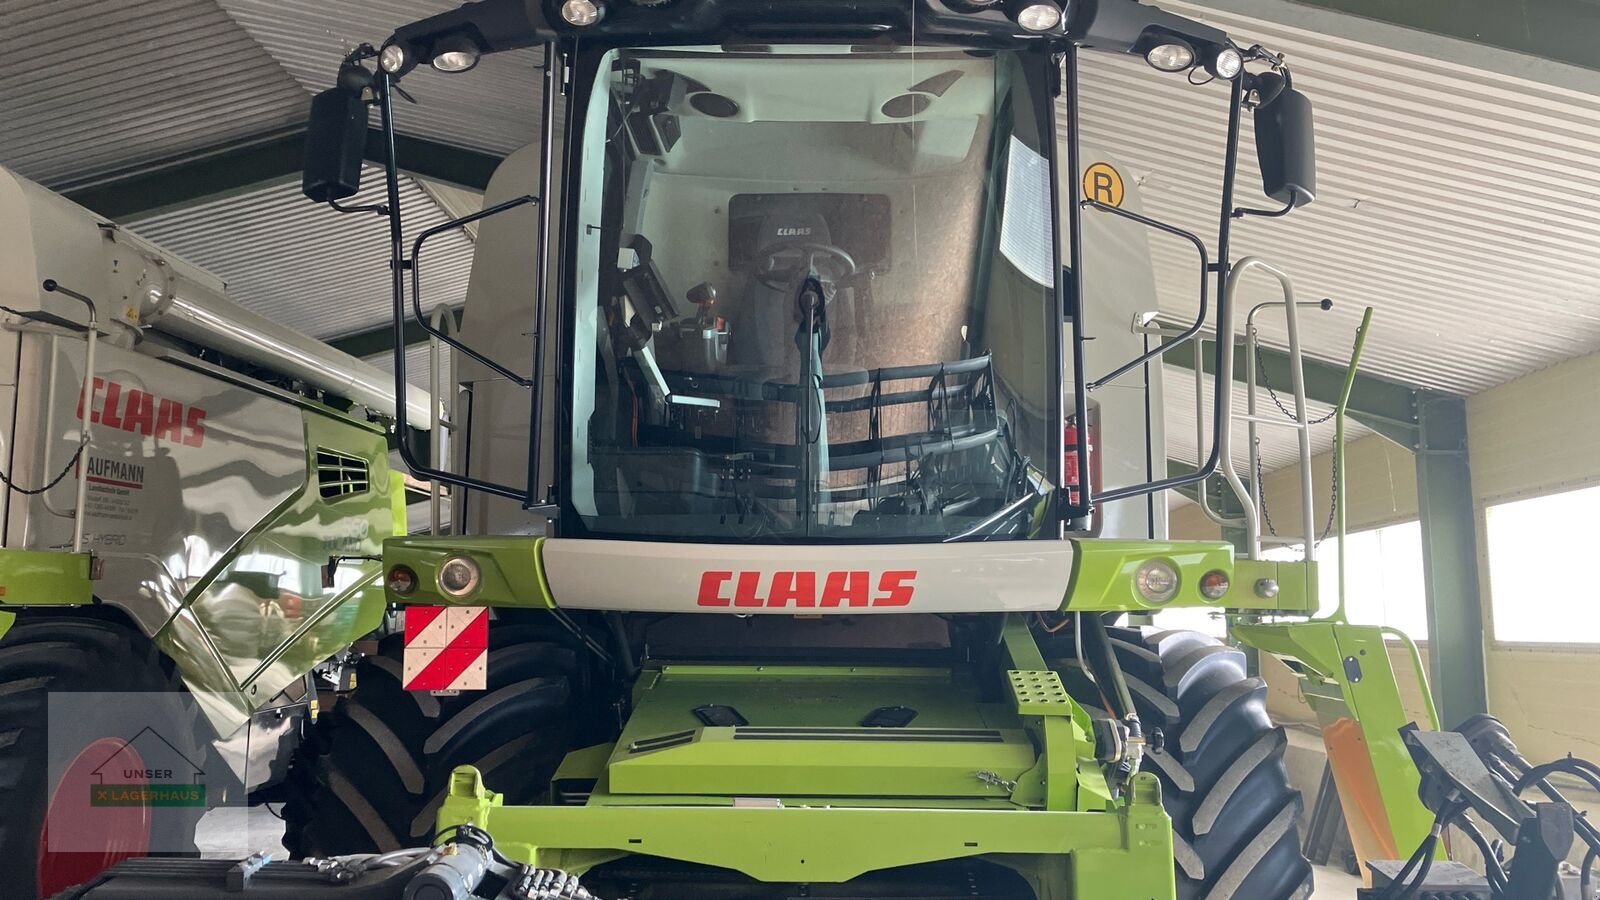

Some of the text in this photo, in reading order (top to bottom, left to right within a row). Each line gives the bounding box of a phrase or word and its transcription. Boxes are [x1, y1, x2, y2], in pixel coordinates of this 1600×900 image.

[1094, 171, 1113, 203] R
[776, 227, 812, 236] CLAAS
[76, 375, 207, 448] CLAAS
[75, 455, 144, 483] AUFMANN
[697, 570, 918, 608] CLAAS
